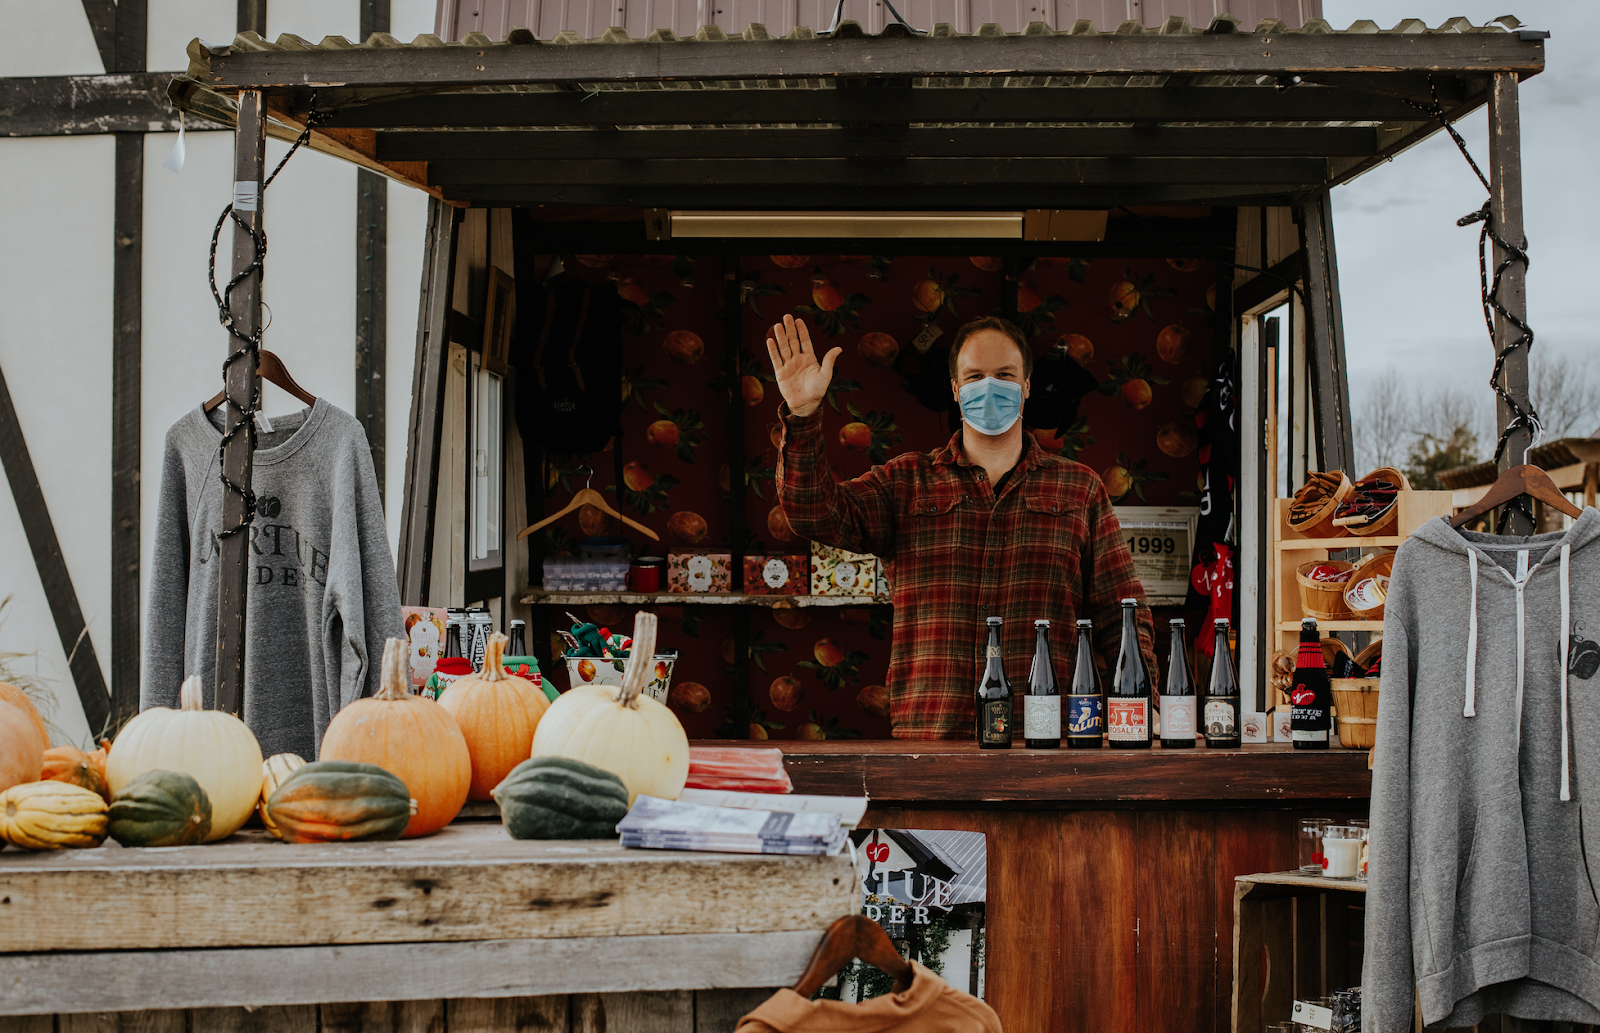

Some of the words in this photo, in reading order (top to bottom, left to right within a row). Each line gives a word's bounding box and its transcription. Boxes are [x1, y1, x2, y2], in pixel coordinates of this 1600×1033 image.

[1127, 537, 1175, 554] 1999
[1291, 708, 1322, 718] RTUE
[1068, 716, 1102, 733] SALUT!
